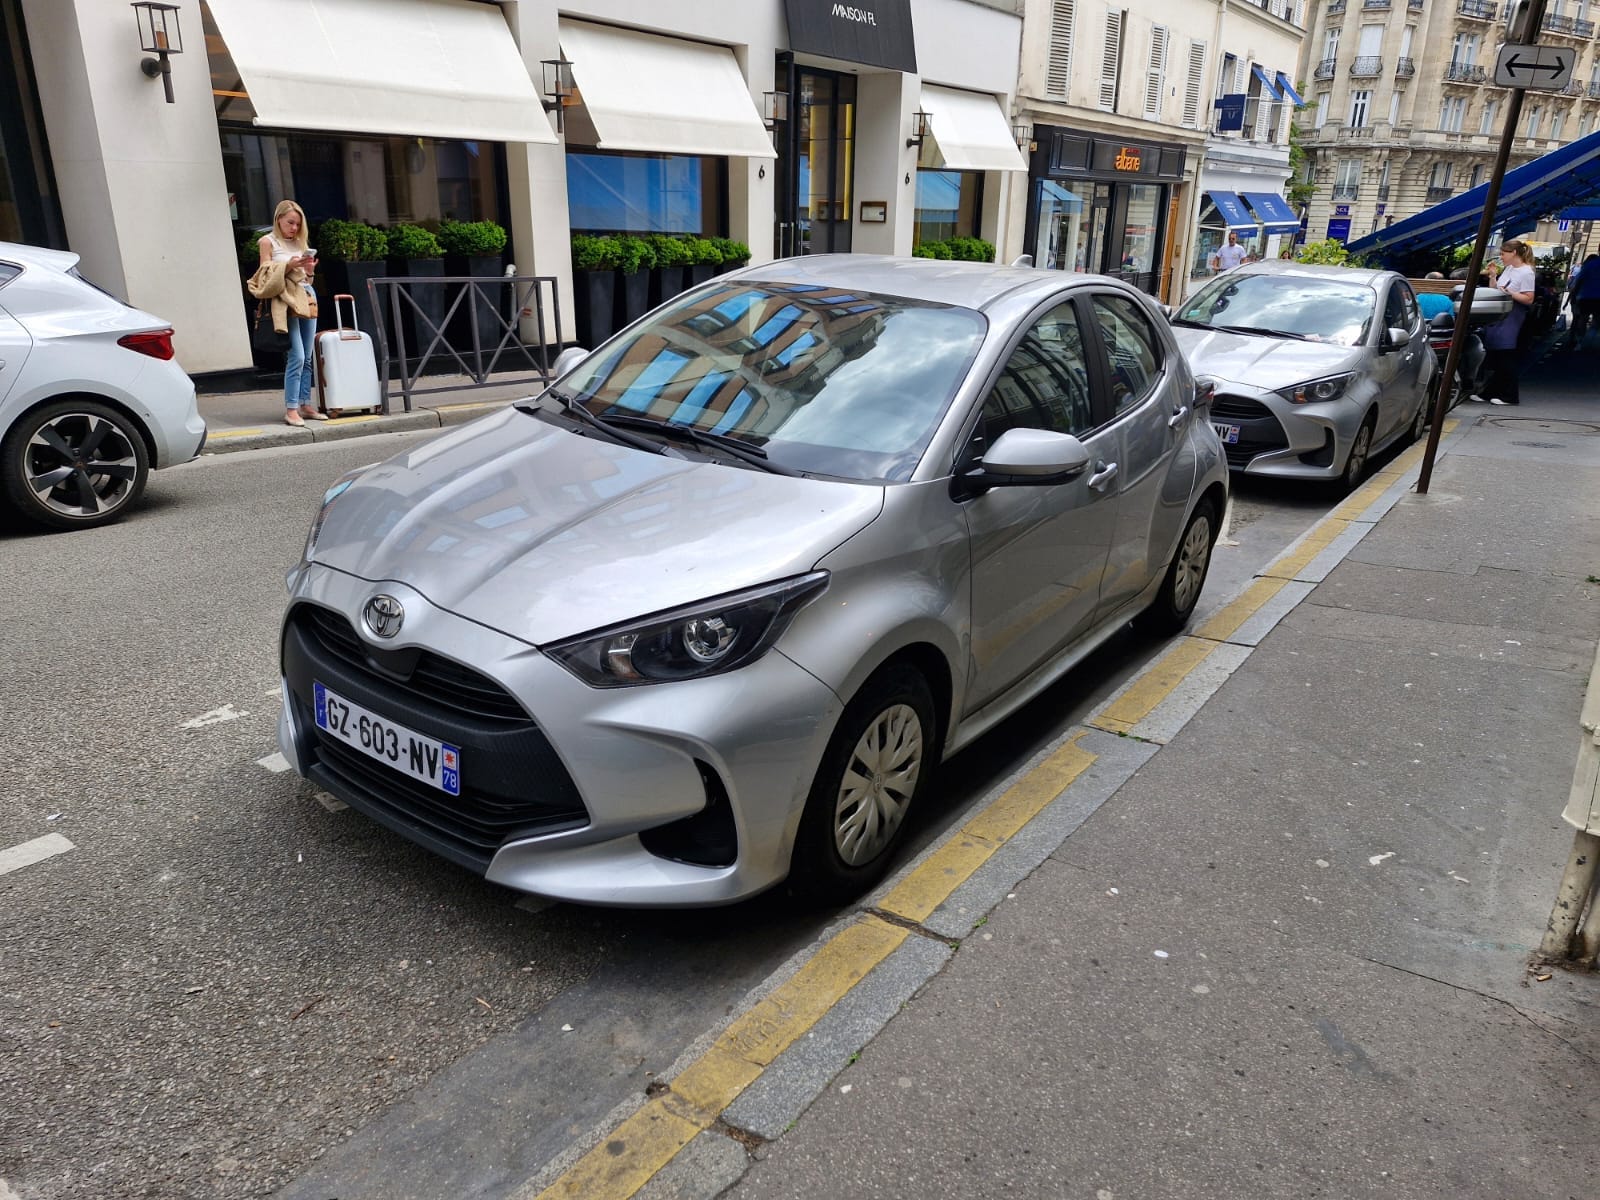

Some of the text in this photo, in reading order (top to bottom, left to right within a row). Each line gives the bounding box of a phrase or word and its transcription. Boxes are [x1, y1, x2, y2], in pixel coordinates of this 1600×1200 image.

[831, 3, 867, 24] MAISON
[758, 164, 765, 180] 6
[904, 172, 910, 185] 6
[327, 697, 438, 780] GZ-603-NV
[443, 770, 457, 788] 78
